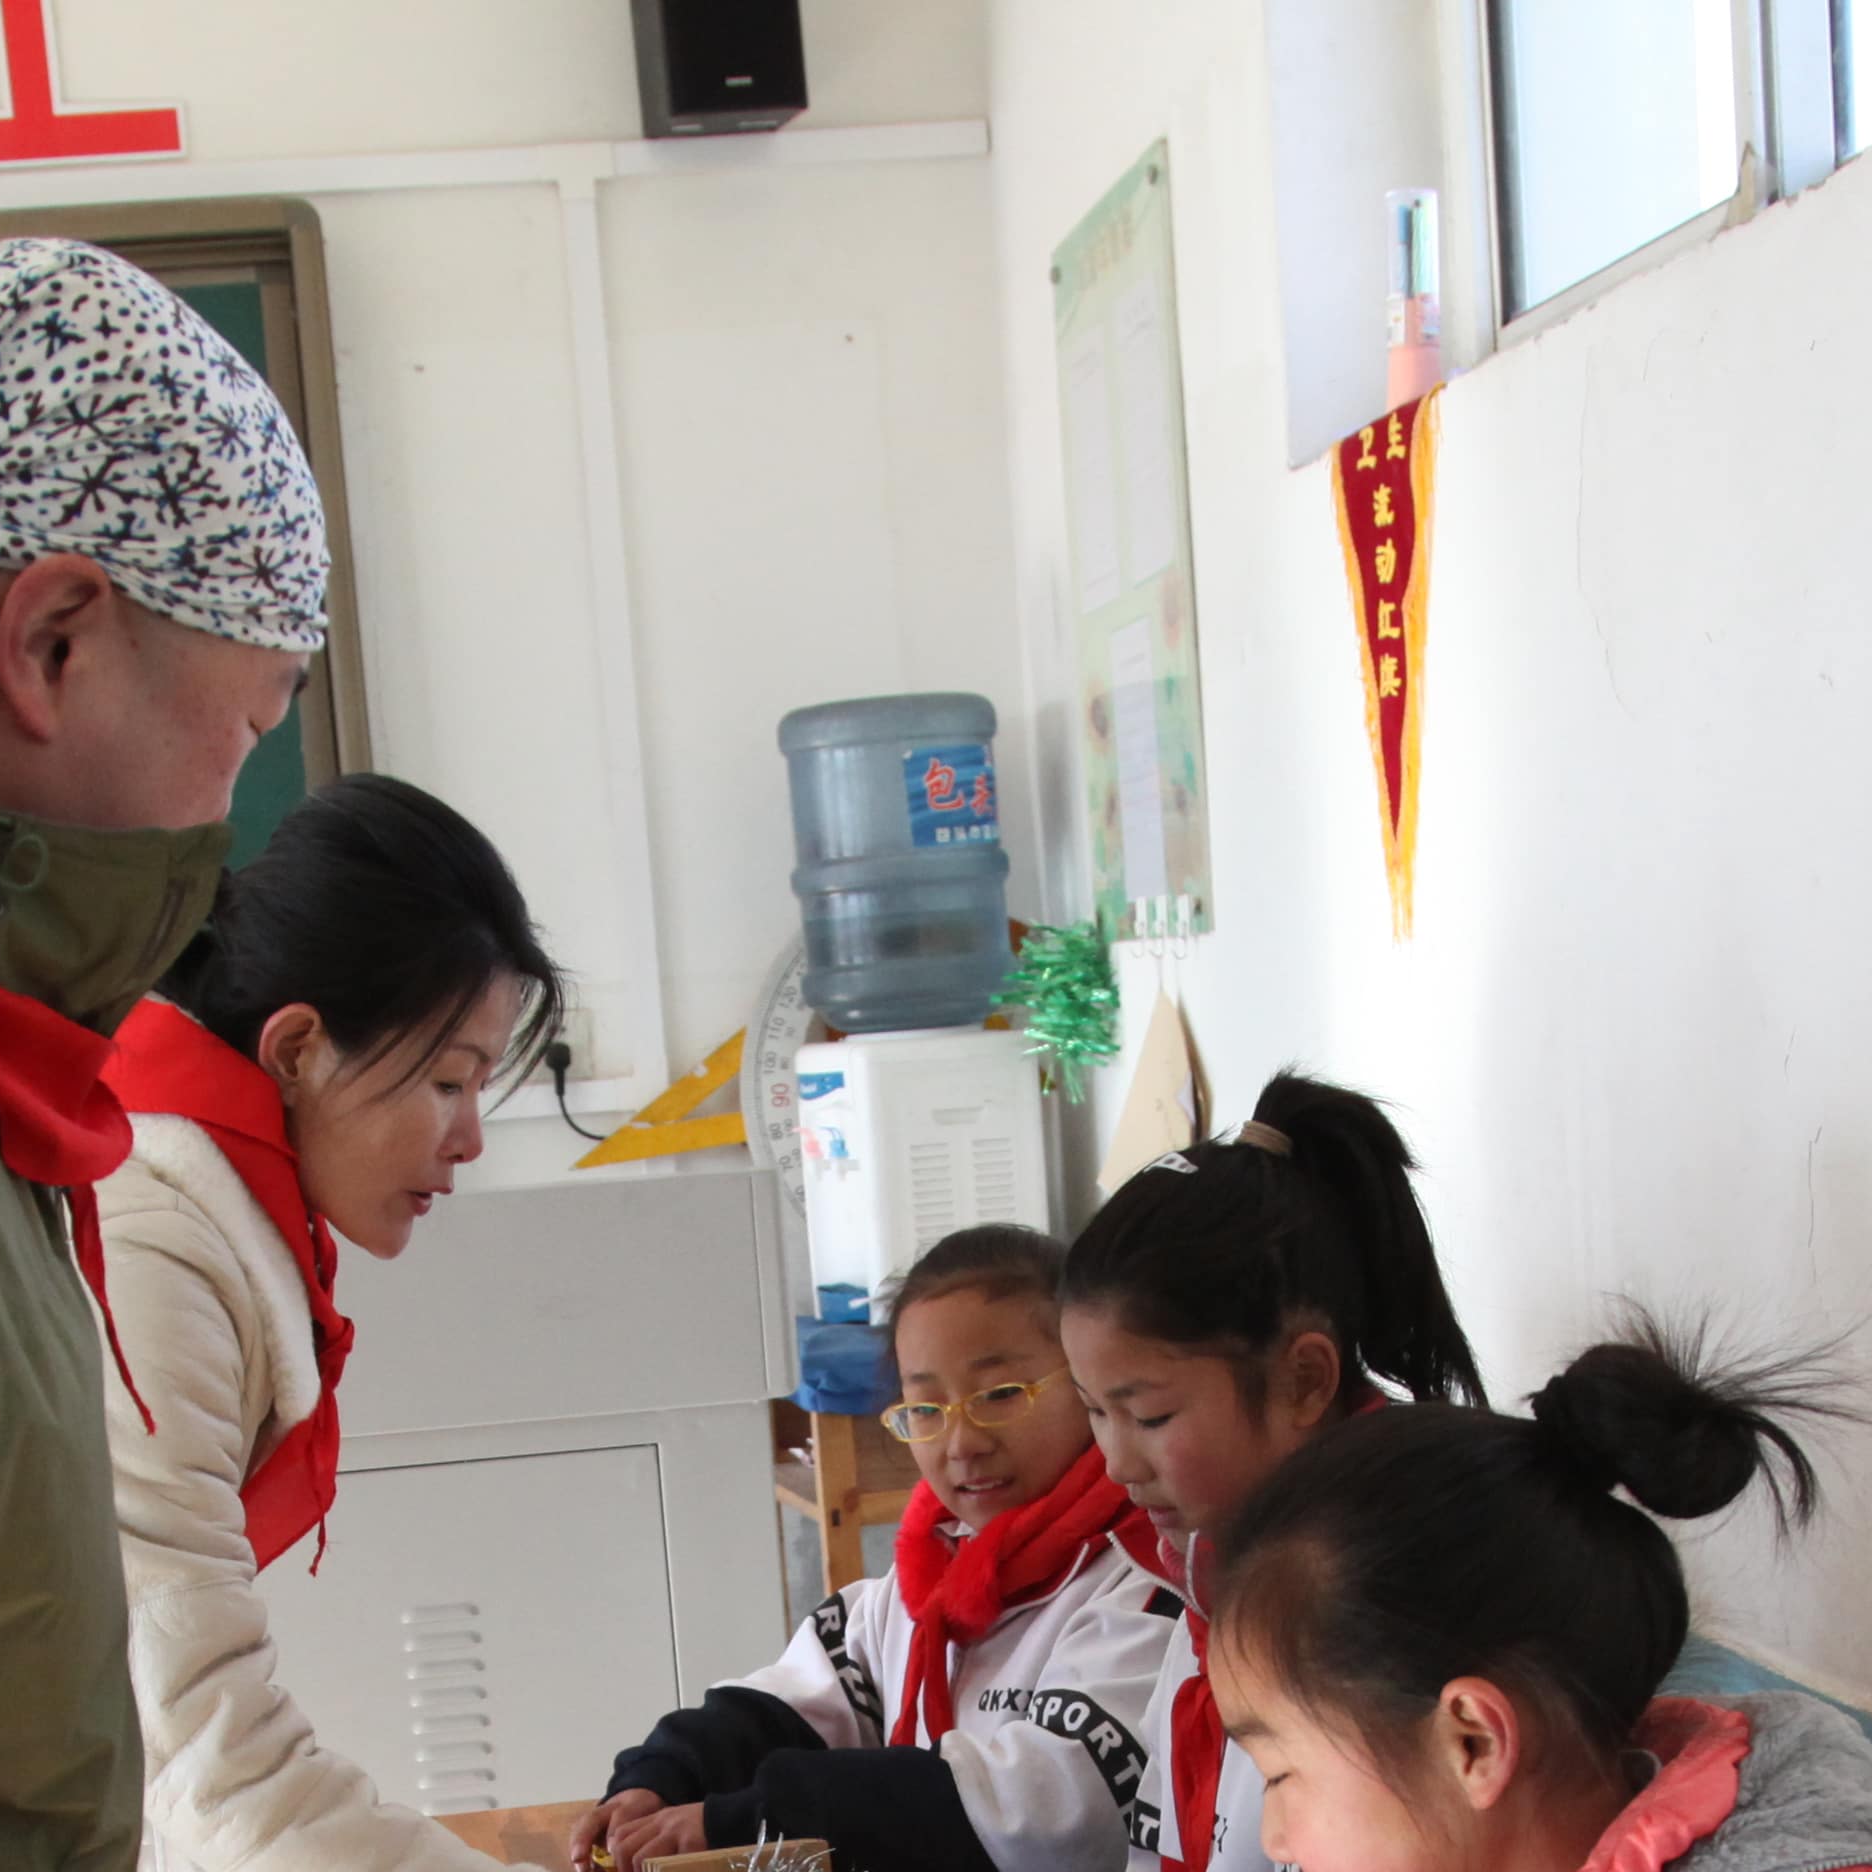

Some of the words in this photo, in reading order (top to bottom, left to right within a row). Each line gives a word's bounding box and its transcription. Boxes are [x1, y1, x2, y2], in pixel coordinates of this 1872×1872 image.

[1356, 411, 1406, 471] 卫生
[1372, 483, 1403, 699] 流动红旗
[771, 1083, 790, 1108] 90
[1027, 1695, 1144, 1786] SPORT
